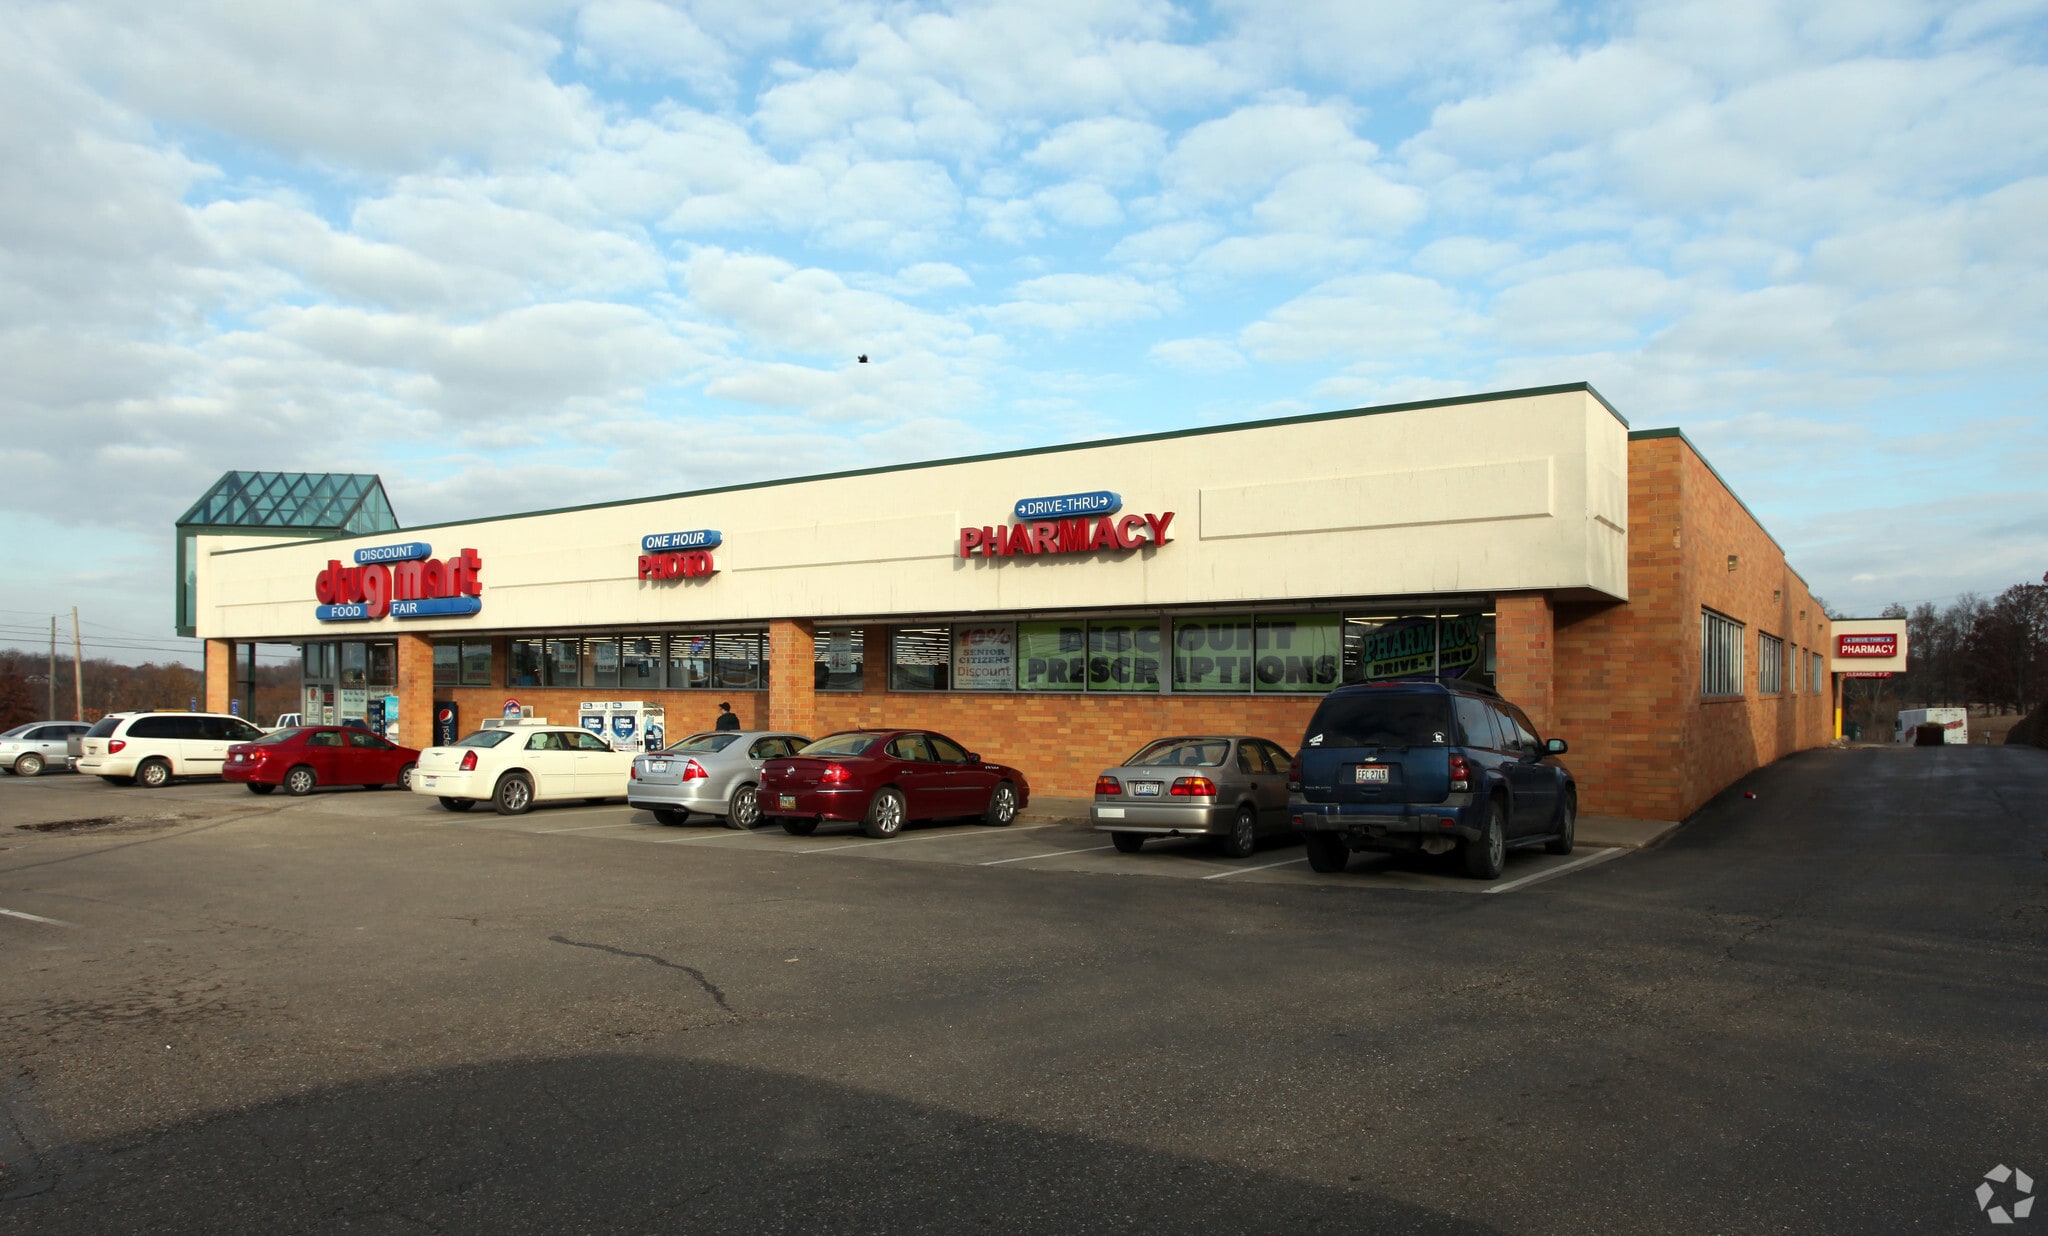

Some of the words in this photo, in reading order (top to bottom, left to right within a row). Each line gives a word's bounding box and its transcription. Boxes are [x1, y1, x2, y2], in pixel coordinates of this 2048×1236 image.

[1027, 496, 1099, 514] DRIVE-THRU
[646, 536, 669, 548] ONE
[672, 532, 705, 546] HOUR
[960, 512, 1175, 558] PHARMACY
[360, 545, 413, 561] DISCOUNT
[638, 550, 714, 580] PHOTO
[315, 560, 392, 617] drug
[393, 548, 482, 600] mart
[331, 606, 361, 617] FOOD
[392, 603, 418, 614] FAIR
[959, 628, 1011, 646] 10%
[1060, 621, 1296, 653] DISCOUNT
[1363, 614, 1481, 662] PHARMACY
[1841, 644, 1894, 653] PHARMACY
[959, 656, 1010, 664] CITIZENS
[957, 666, 1011, 677] Discount
[1028, 655, 1337, 684] PRESCRIPTIONS
[442, 725, 450, 746] epsi
